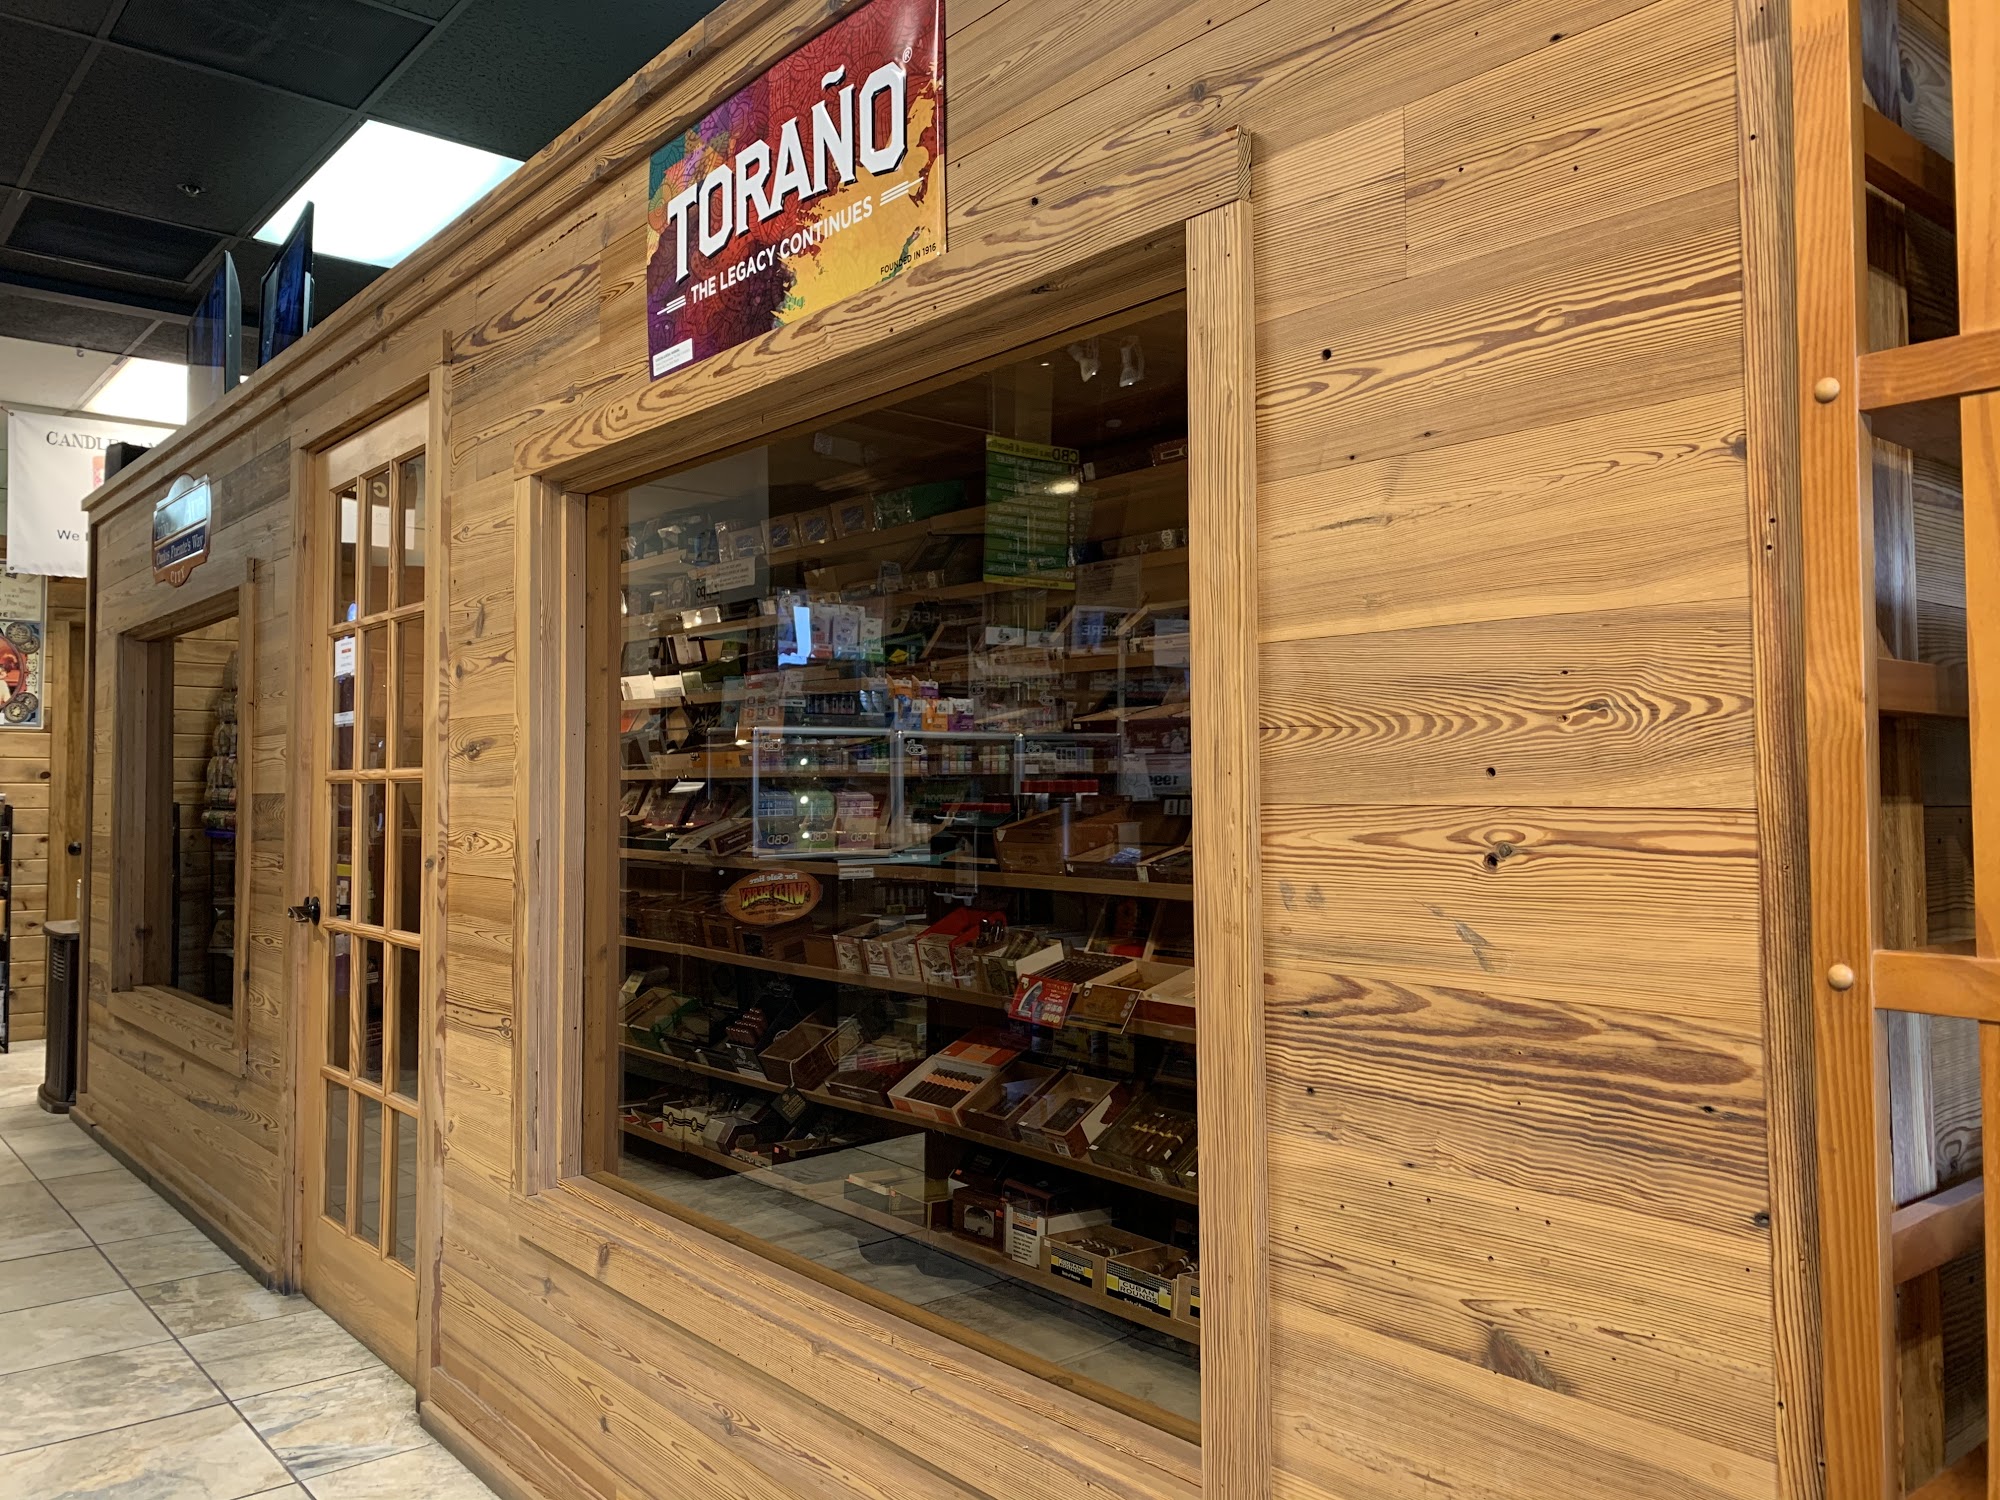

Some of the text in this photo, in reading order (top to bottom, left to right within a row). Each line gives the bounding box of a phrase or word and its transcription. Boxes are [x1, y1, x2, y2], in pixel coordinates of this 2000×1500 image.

[667, 61, 908, 284] TORAÑO
[691, 195, 873, 303] THE LEGACY CONTINUES
[880, 243, 937, 275] FOUNDED IN 1916
[57, 529, 80, 541] We
[192, 534, 205, 549] Way
[1120, 1286, 1158, 1304] ROUNDS
[1122, 1281, 1155, 1298] CUBAN
